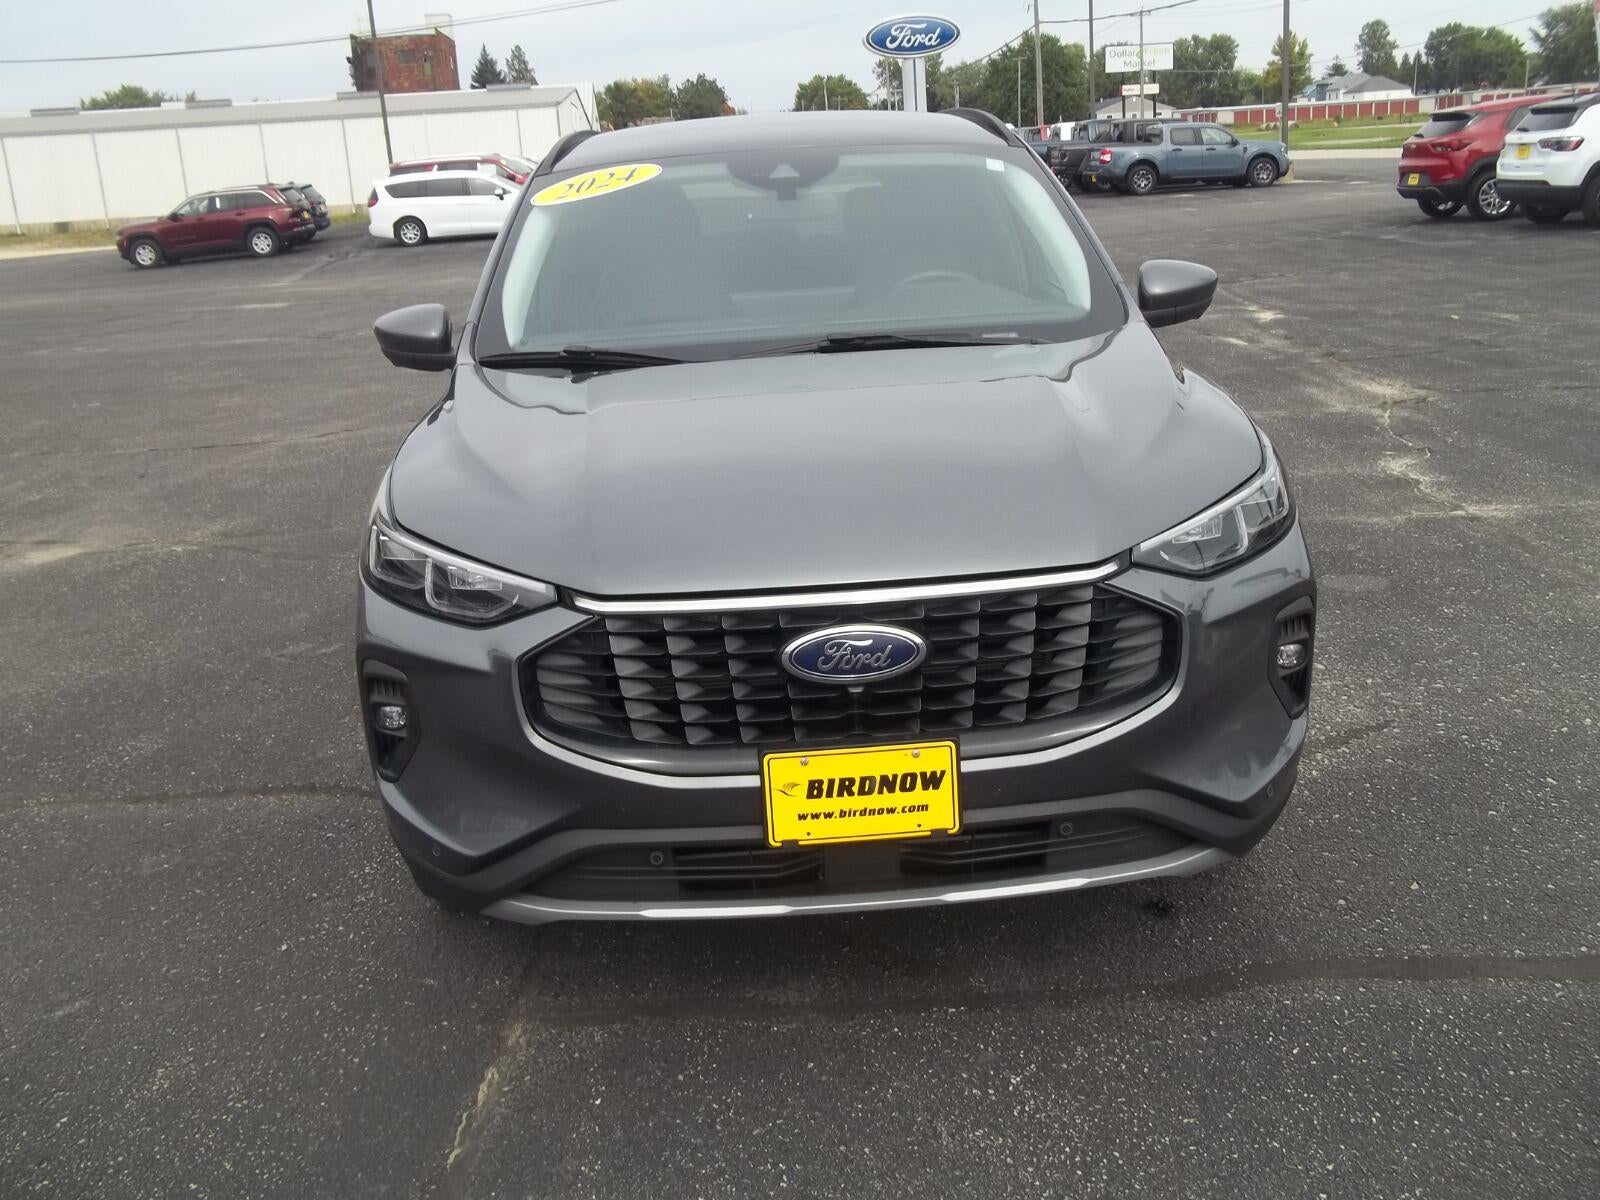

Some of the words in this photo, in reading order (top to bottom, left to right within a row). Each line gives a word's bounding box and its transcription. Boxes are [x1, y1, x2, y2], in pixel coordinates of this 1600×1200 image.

[885, 23, 941, 49] Ford
[1109, 49, 1135, 58] Dollar
[554, 167, 638, 200] 2024
[817, 639, 893, 671] Ford
[806, 769, 947, 800] BIRDNOW
[797, 803, 929, 821] www.birdnow.com
